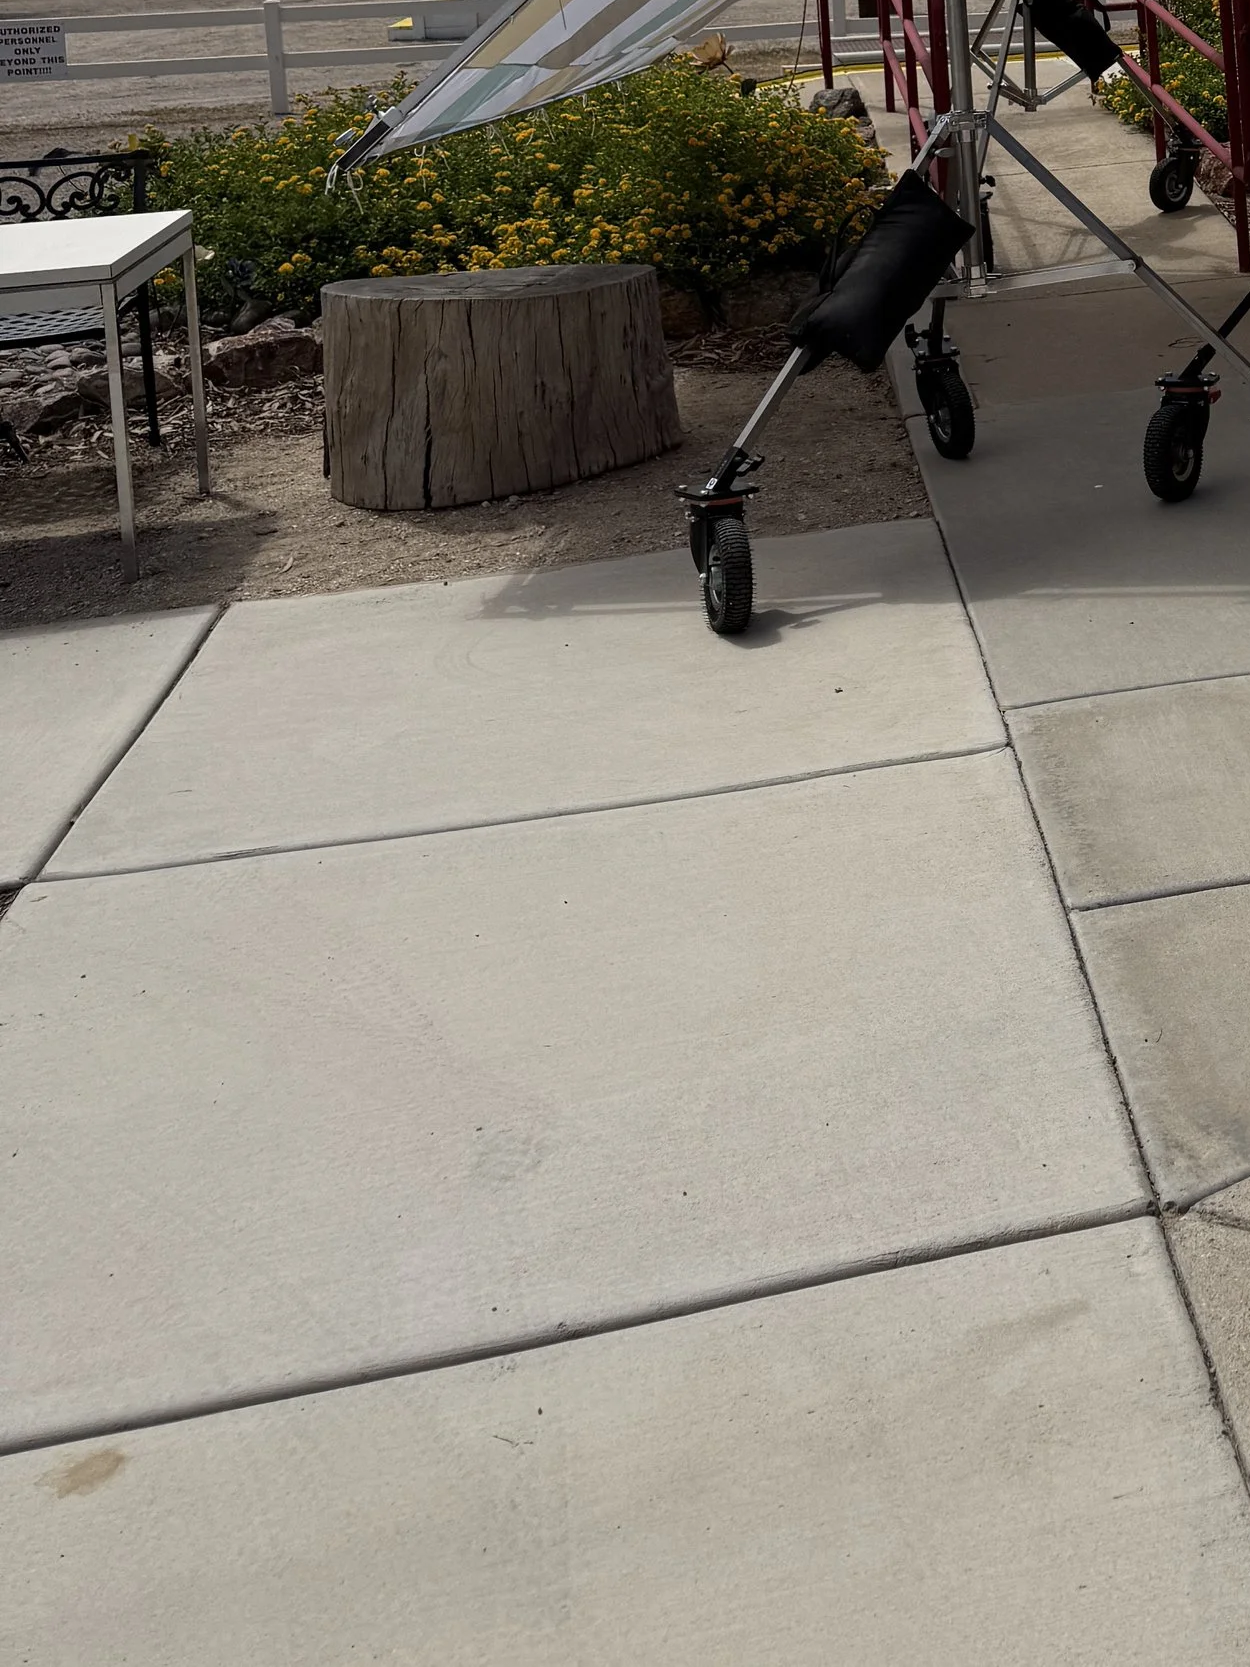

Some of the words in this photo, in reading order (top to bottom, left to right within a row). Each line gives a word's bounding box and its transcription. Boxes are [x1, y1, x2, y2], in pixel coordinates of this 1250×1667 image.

[0, 26, 60, 35] UTHORIZED
[14, 47, 41, 55] ONLY
[0, 58, 36, 66] EYOND
[41, 56, 65, 64] THIS
